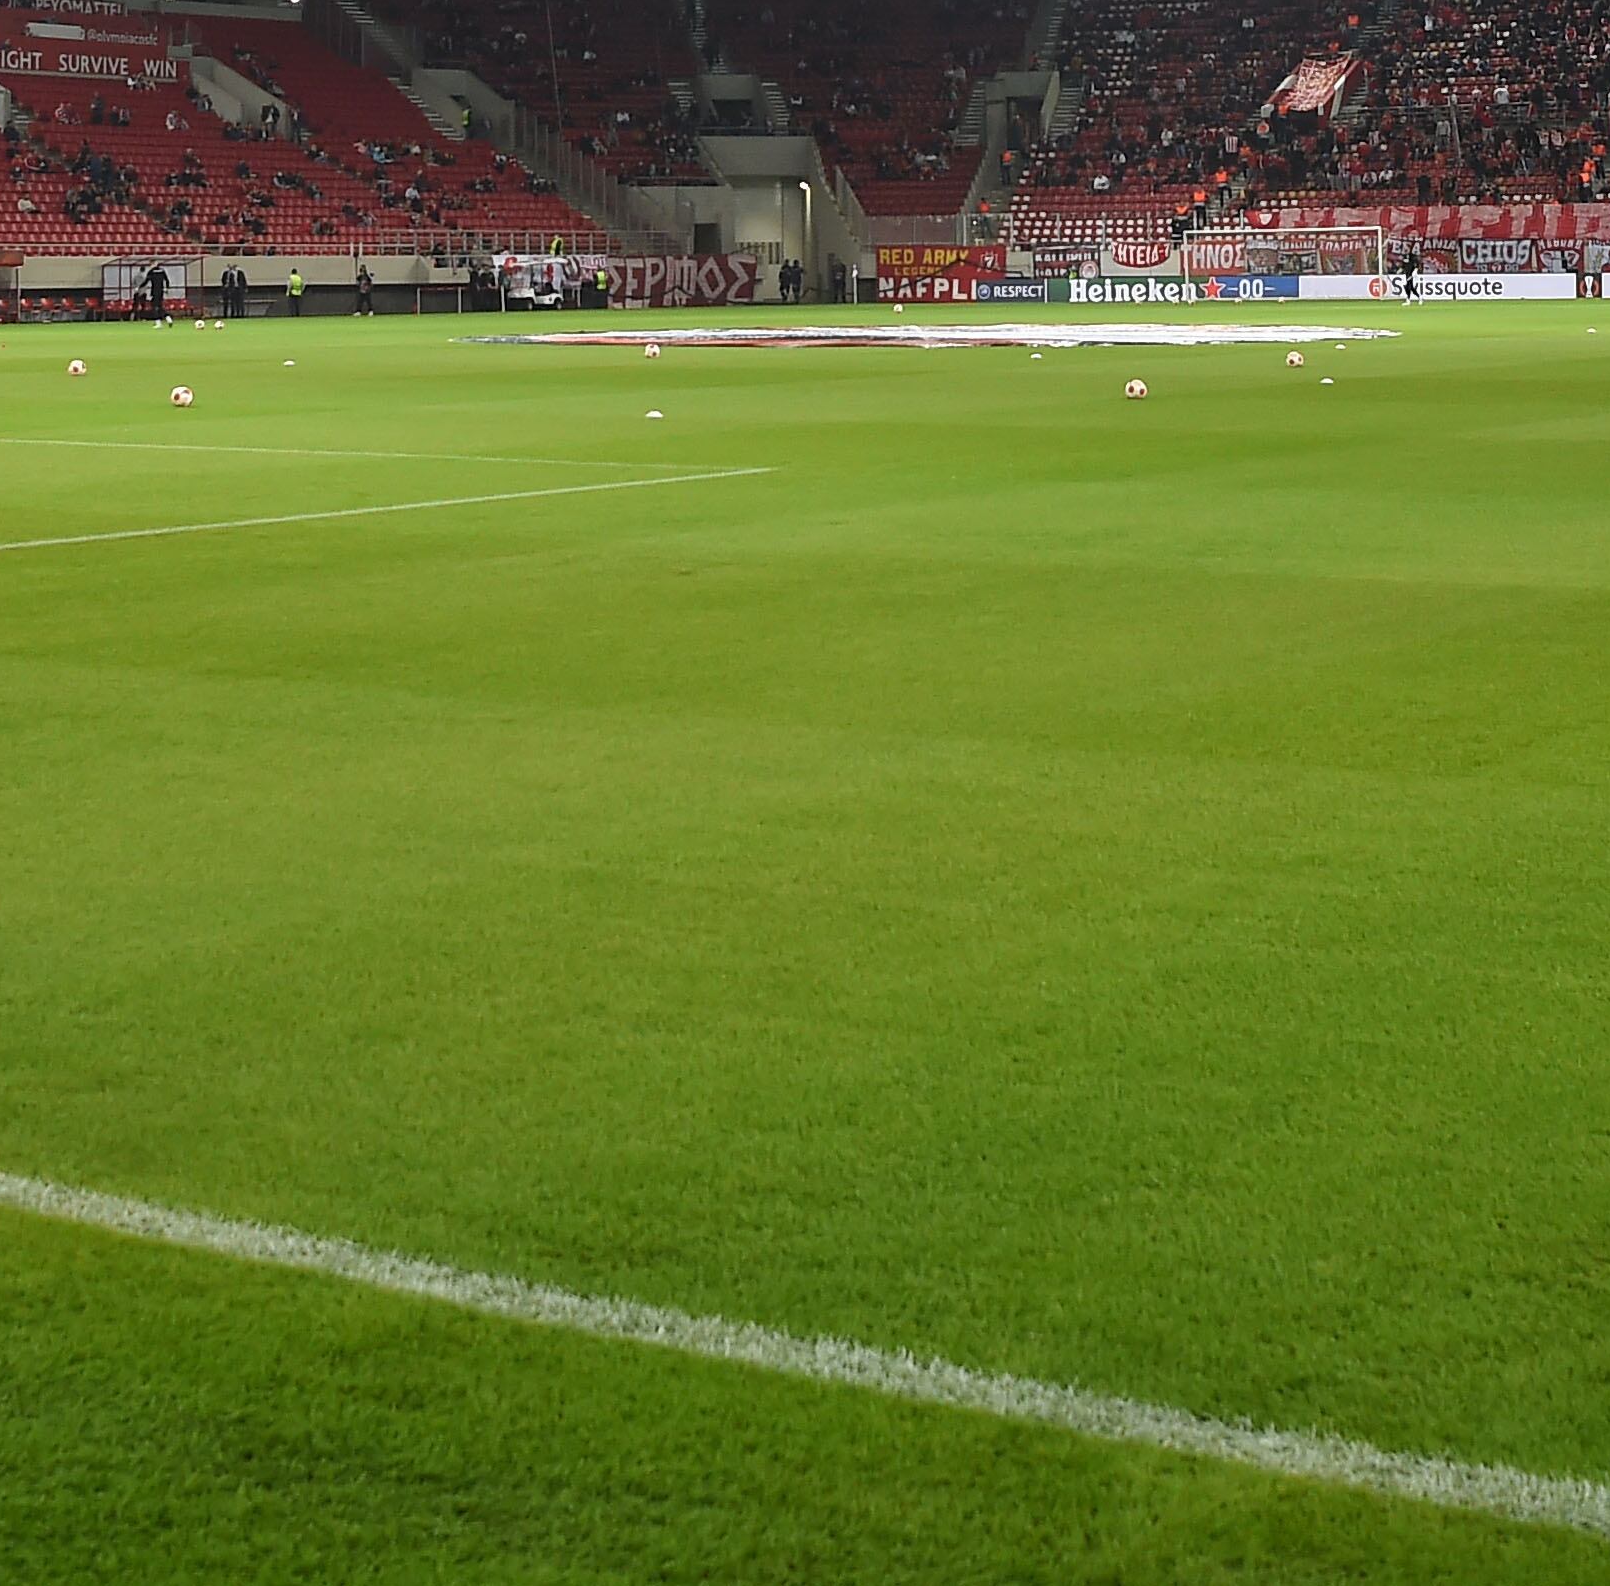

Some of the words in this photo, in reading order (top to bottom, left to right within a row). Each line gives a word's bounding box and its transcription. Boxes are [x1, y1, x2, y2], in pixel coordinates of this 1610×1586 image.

[59, 53, 129, 76] SURVIVE
[143, 59, 178, 79] WIN
[879, 248, 914, 265] RED
[922, 248, 969, 267] ARMY
[993, 284, 1043, 298] RESPECT
[1069, 277, 1198, 303] Heineken
